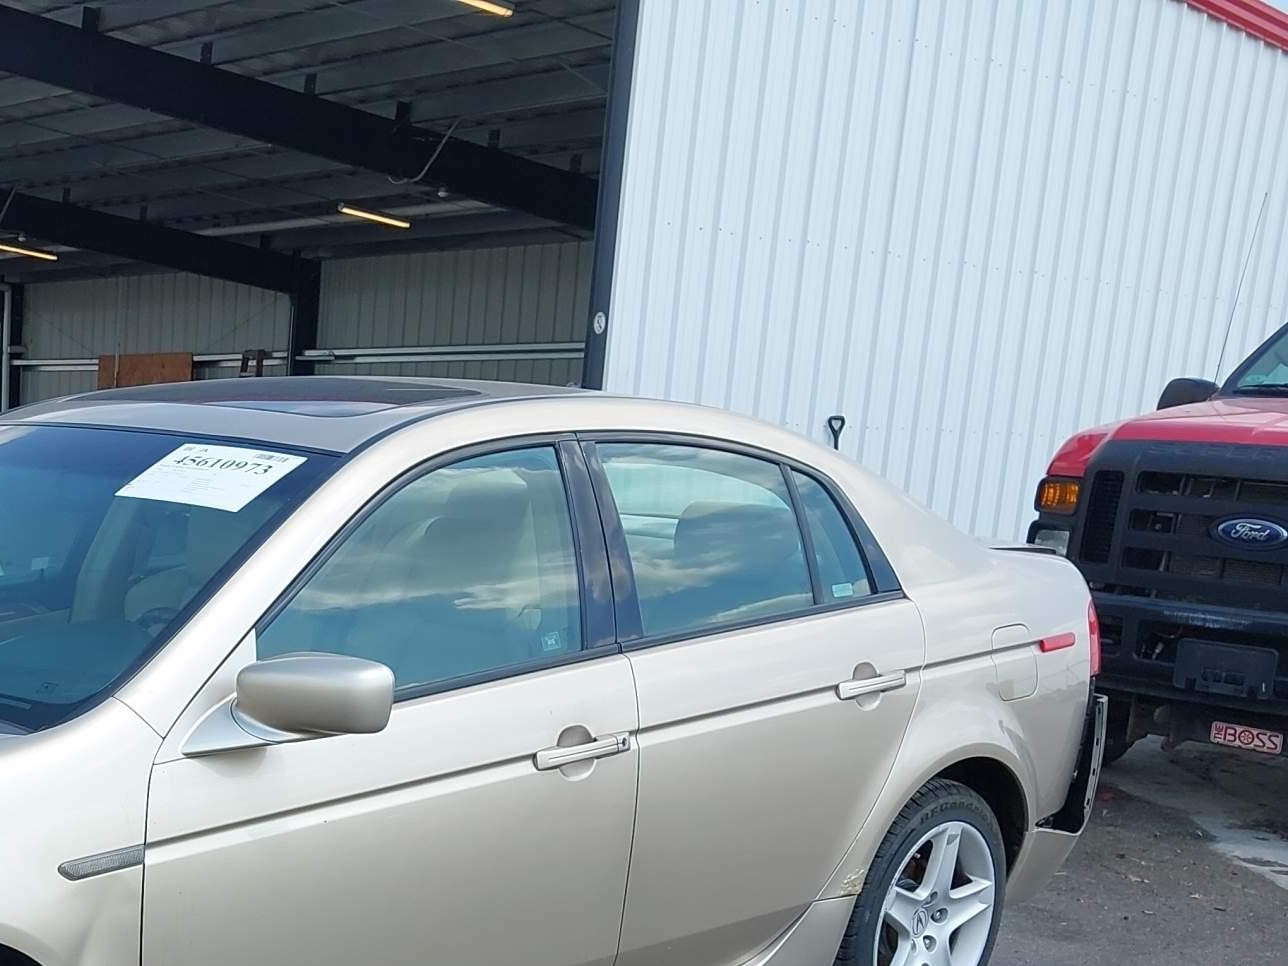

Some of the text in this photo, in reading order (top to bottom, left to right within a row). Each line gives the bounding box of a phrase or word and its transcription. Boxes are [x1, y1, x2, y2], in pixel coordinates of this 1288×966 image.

[173, 455, 273, 475] 45610973
[1230, 522, 1271, 541] Ford
[1214, 723, 1280, 751] THE BOSS
